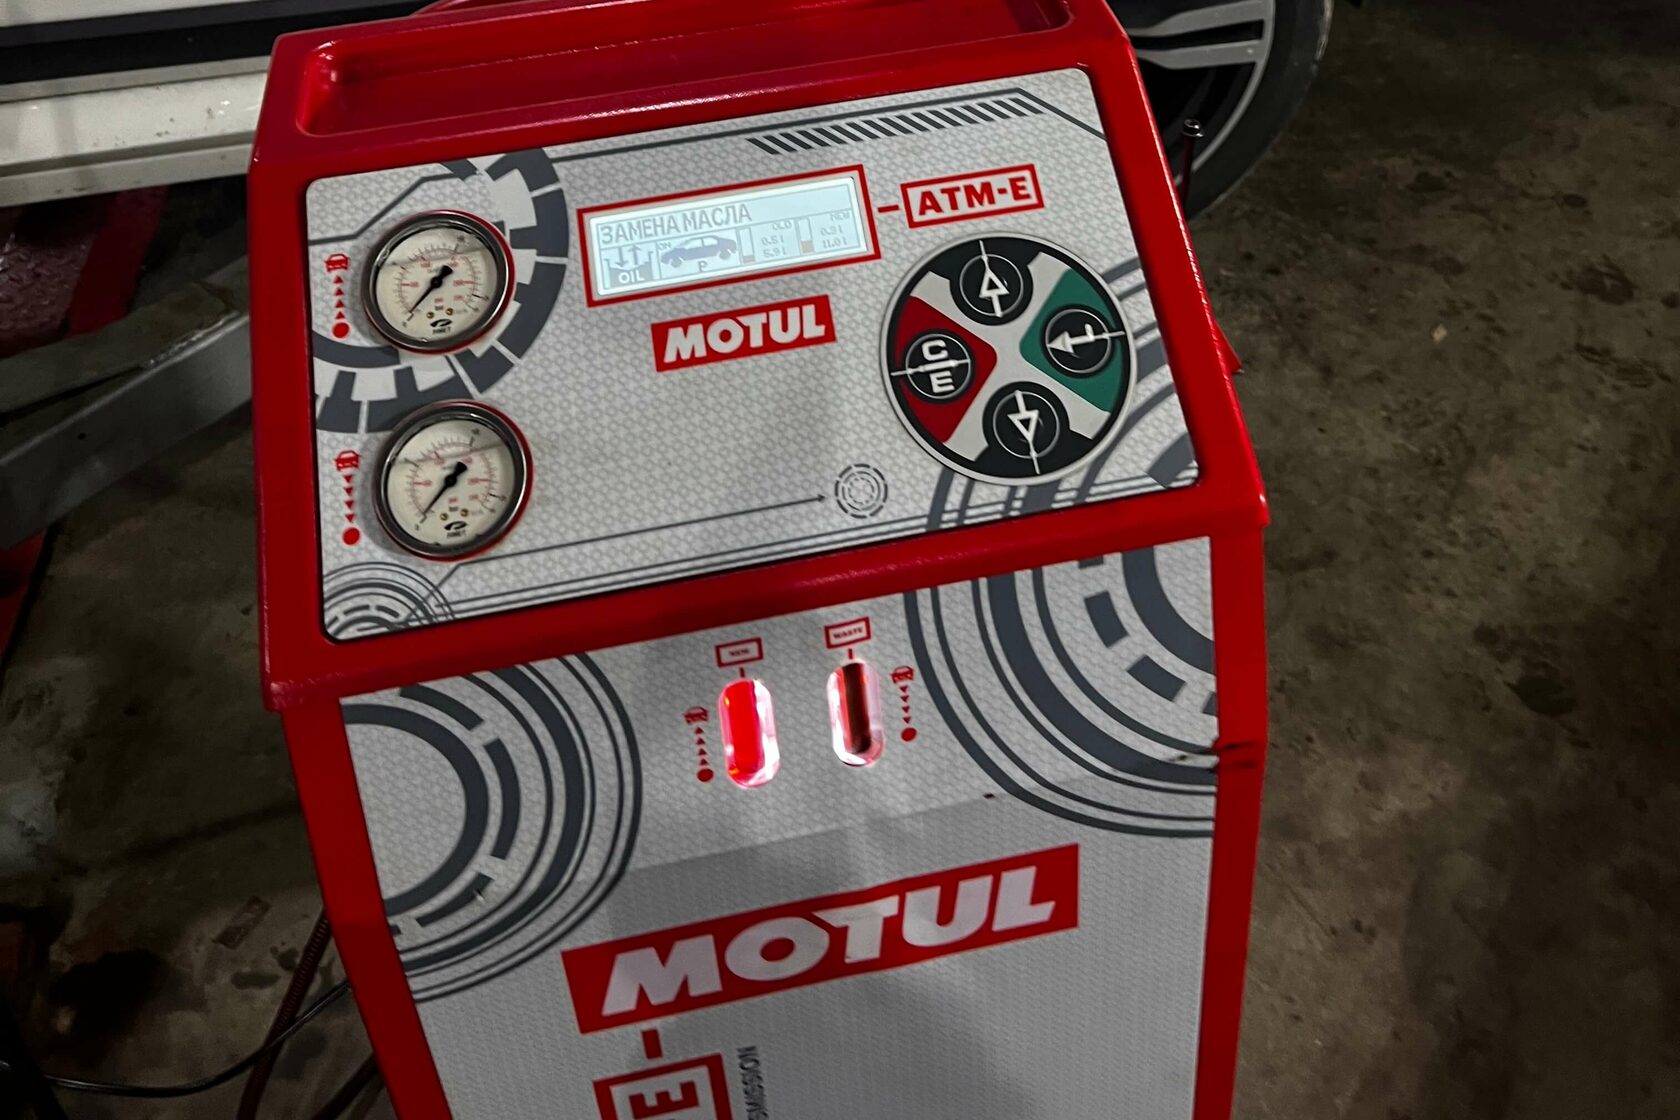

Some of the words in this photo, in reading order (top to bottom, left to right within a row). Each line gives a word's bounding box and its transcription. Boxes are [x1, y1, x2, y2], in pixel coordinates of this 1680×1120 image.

[918, 176, 1031, 216] ATM-E
[600, 214, 680, 244] ЗАМЕНА
[682, 203, 752, 232] МАСЛА
[618, 269, 645, 284] OIL
[663, 305, 827, 364] MOTUL
[601, 865, 1057, 1017] MOTUL
